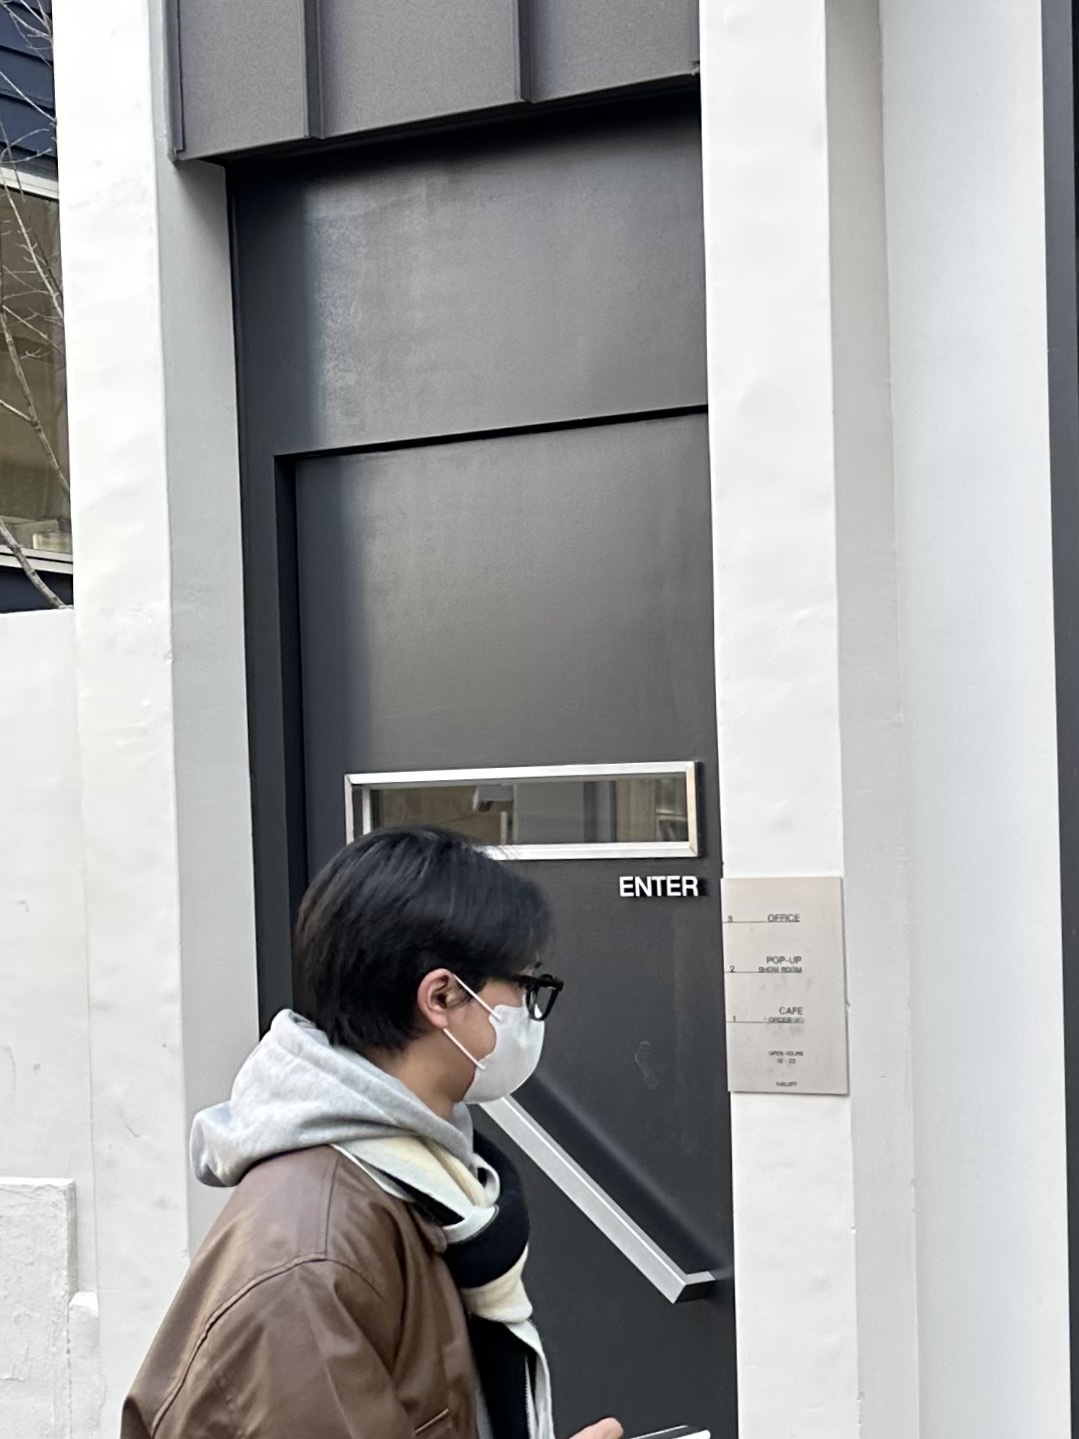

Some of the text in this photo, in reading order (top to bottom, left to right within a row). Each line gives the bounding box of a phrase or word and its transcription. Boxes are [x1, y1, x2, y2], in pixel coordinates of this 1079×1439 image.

[619, 875, 699, 897] ENTER
[767, 913, 801, 923] OFFICE
[766, 956, 802, 964] POP-UP
[729, 965, 736, 973] 2
[778, 1006, 804, 1015] CAFE
